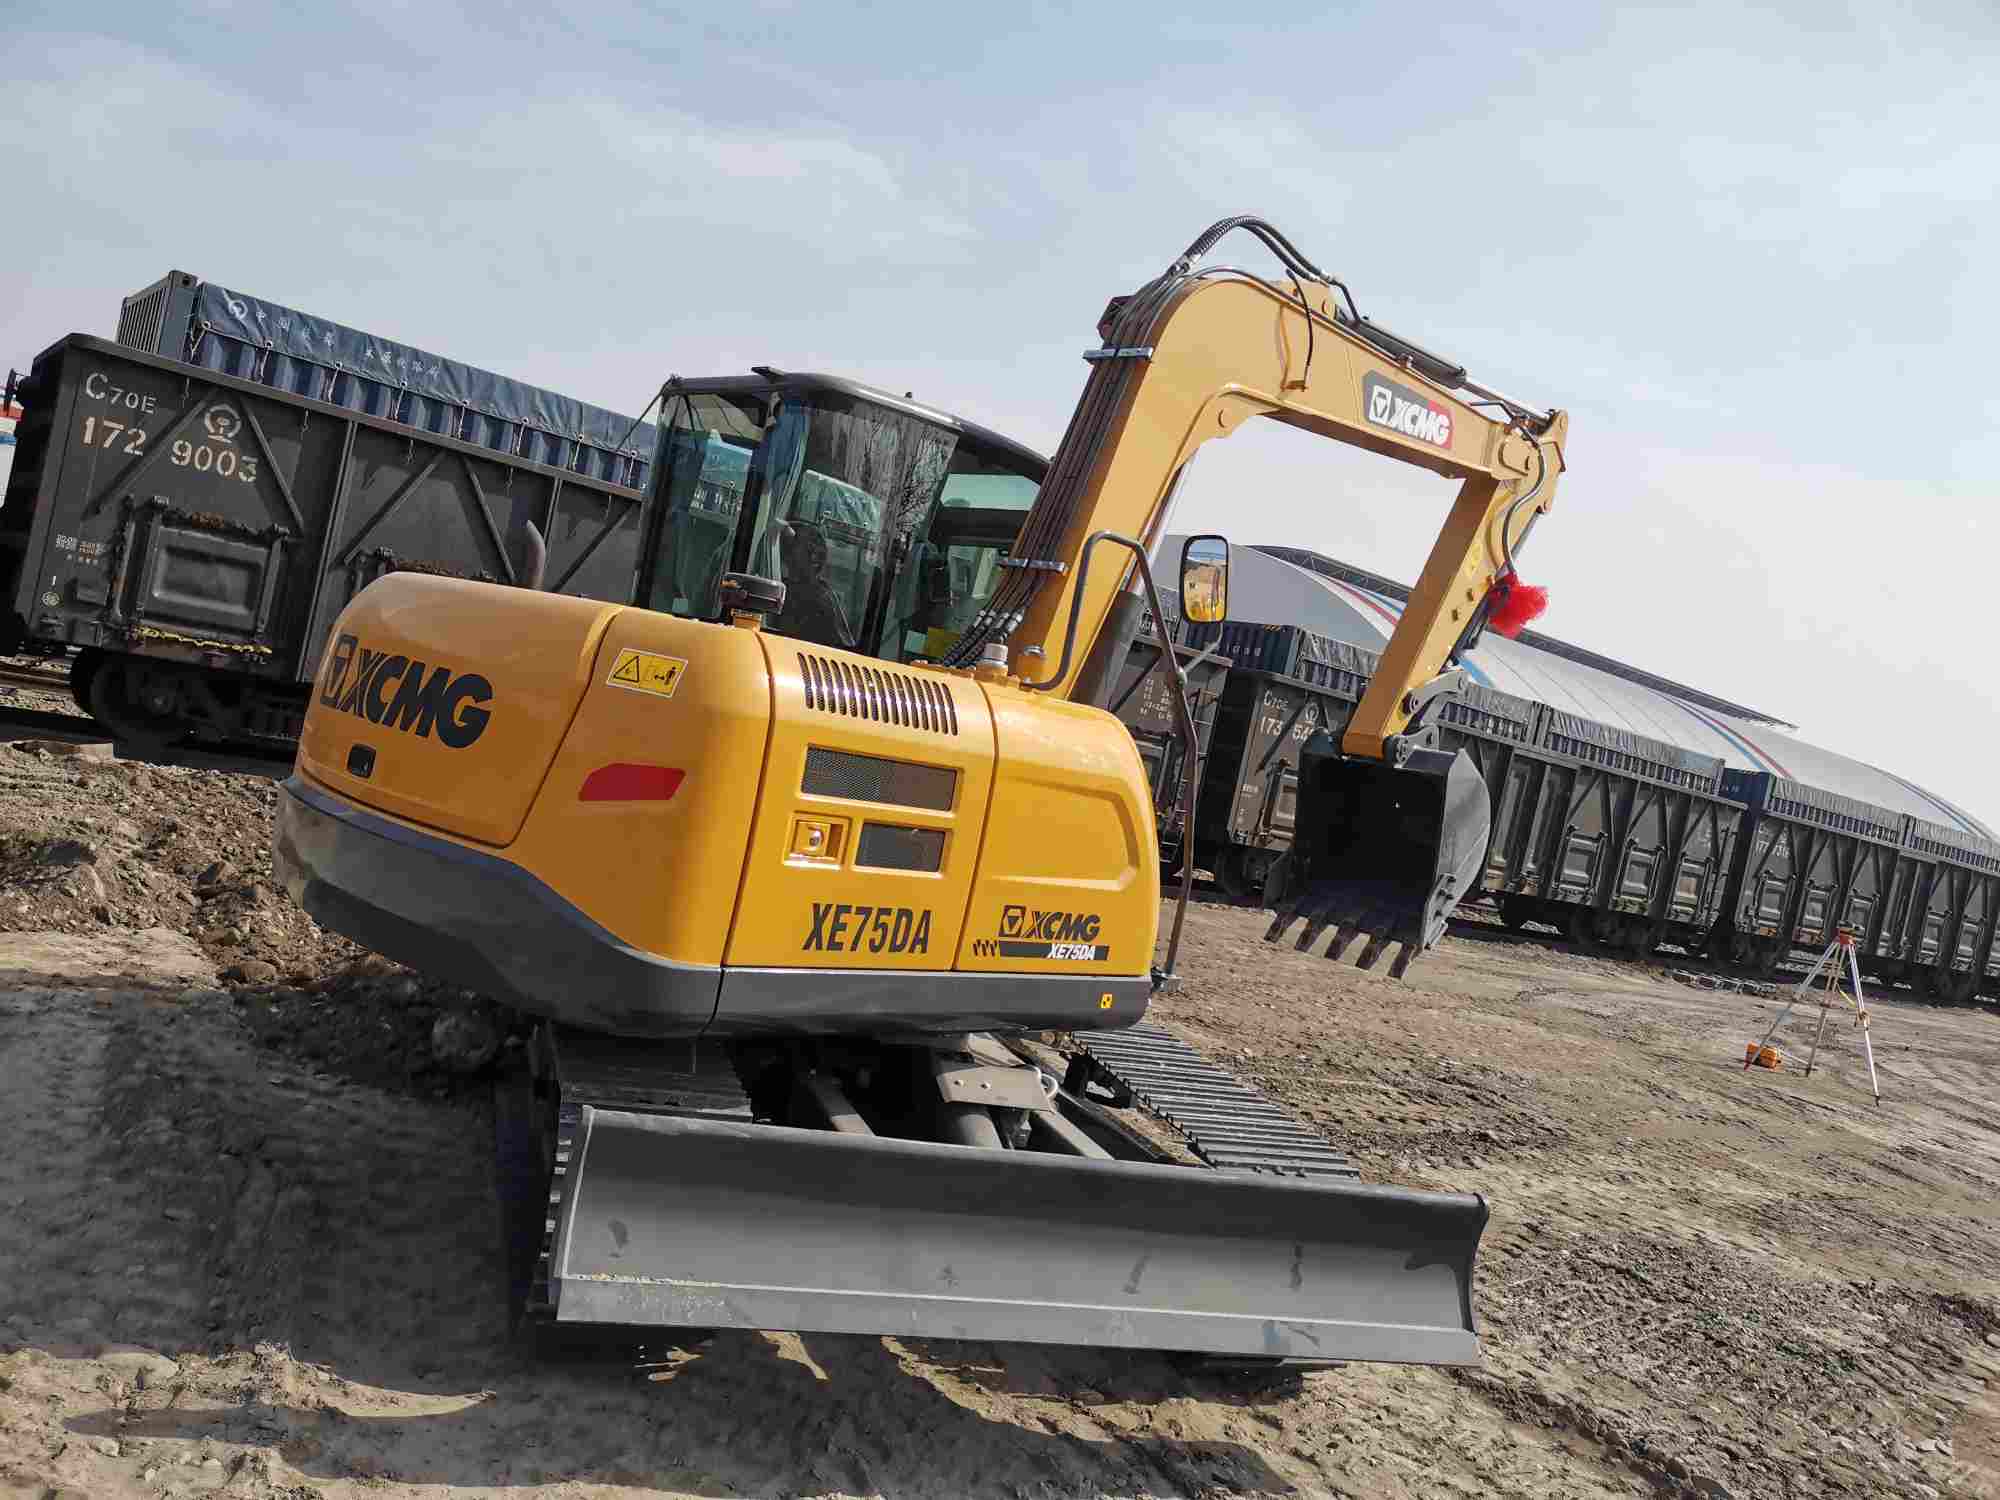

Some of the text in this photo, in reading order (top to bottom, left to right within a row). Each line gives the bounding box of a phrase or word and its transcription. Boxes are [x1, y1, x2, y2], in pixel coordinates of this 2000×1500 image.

[86, 372, 157, 414] C70E
[82, 416, 147, 456] 172
[1390, 397, 1449, 445] XCMG
[336, 648, 494, 749] XCMG
[802, 903, 932, 954] XE75DA
[1025, 910, 1100, 941] XCMG
[1047, 942, 1096, 961] XE75DA
